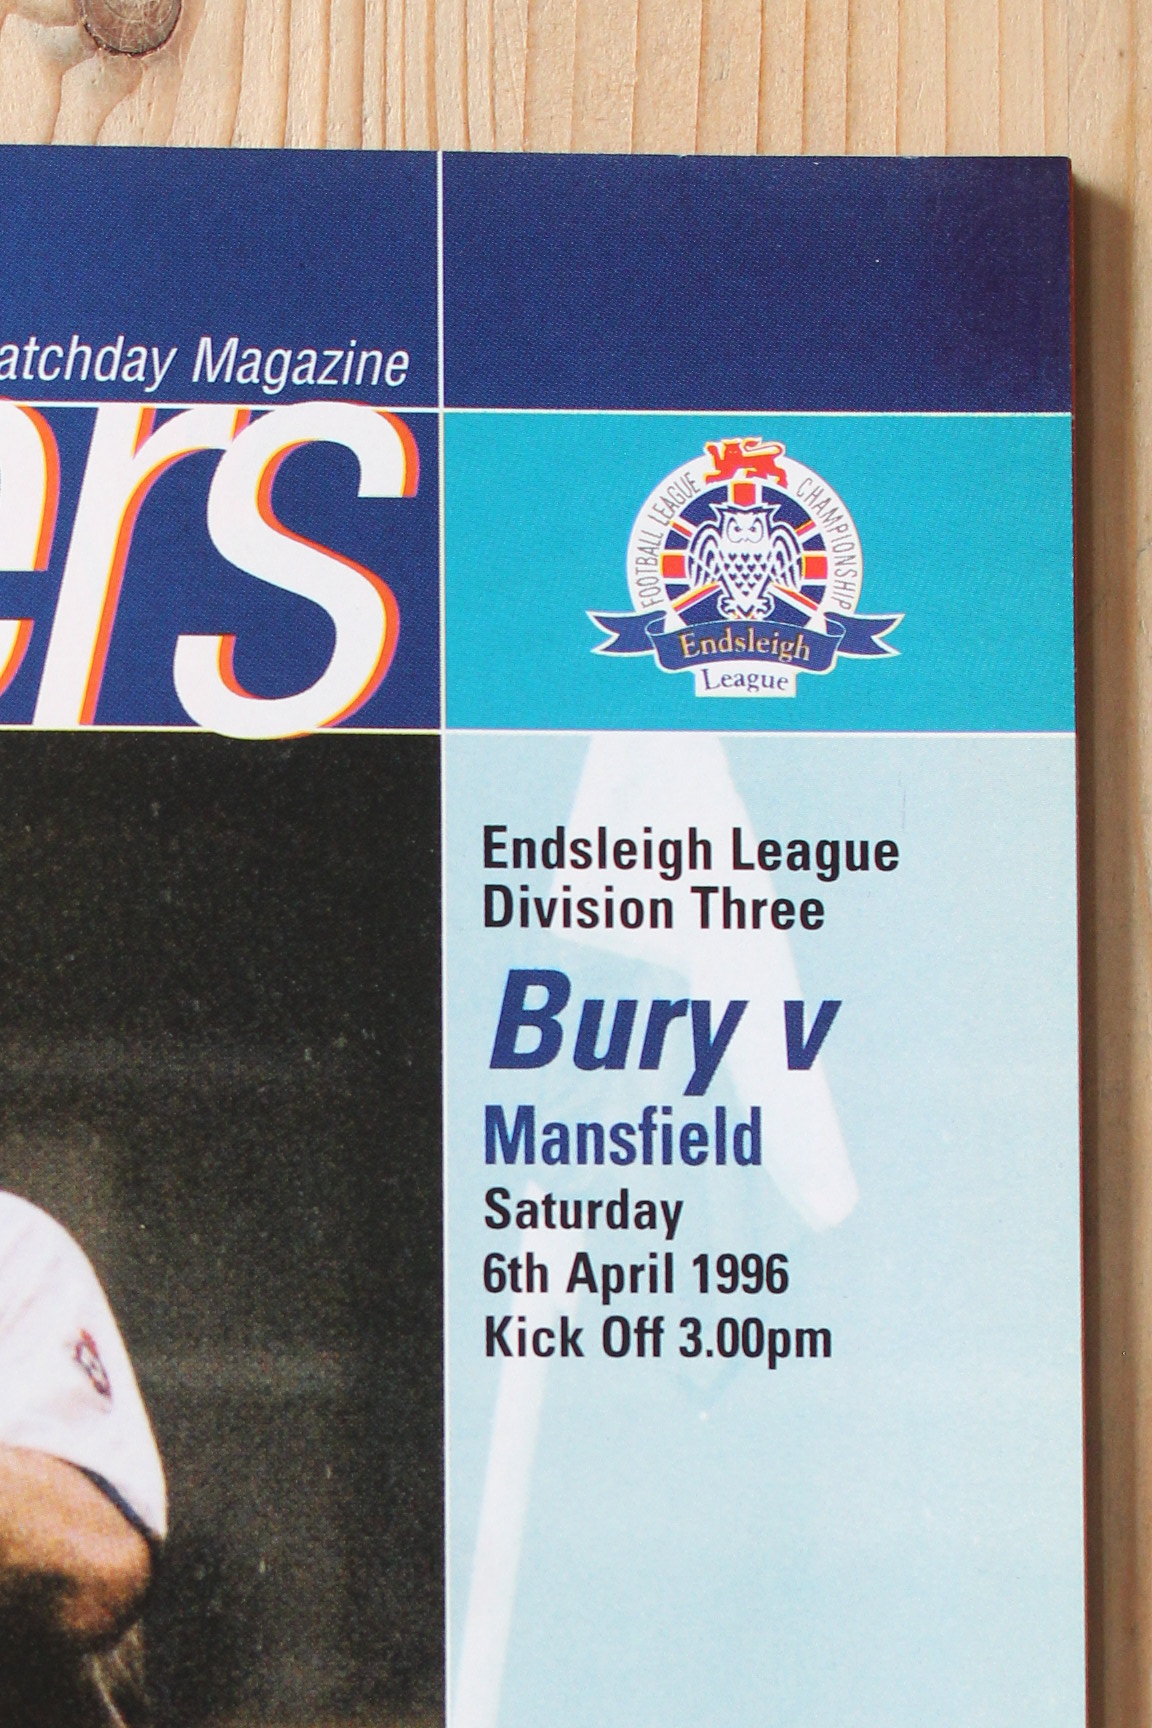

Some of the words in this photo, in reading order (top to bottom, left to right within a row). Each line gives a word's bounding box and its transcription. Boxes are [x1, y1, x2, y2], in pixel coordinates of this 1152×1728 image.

[191, 336, 410, 394] Magazine
[648, 471, 701, 526] LEAGUE
[634, 530, 664, 609] FOOTBALL
[796, 476, 858, 611] CHAMPIONSHIP
[679, 628, 810, 662] Endsleigh
[700, 667, 789, 692] League
[483, 825, 713, 880] Endsleigh
[732, 827, 900, 882] League
[484, 884, 674, 929] Division
[690, 886, 825, 930] Three
[489, 969, 750, 1096] Bury
[783, 999, 844, 1071] v
[484, 1104, 763, 1166] Mansfield
[484, 1187, 684, 1240] Saturday
[483, 1252, 549, 1294] 6th
[566, 1252, 674, 1305] April
[692, 1253, 790, 1294] 1996
[485, 1315, 585, 1358] Kick
[602, 1315, 665, 1359] Off
[679, 1317, 832, 1370] 3.00pm
